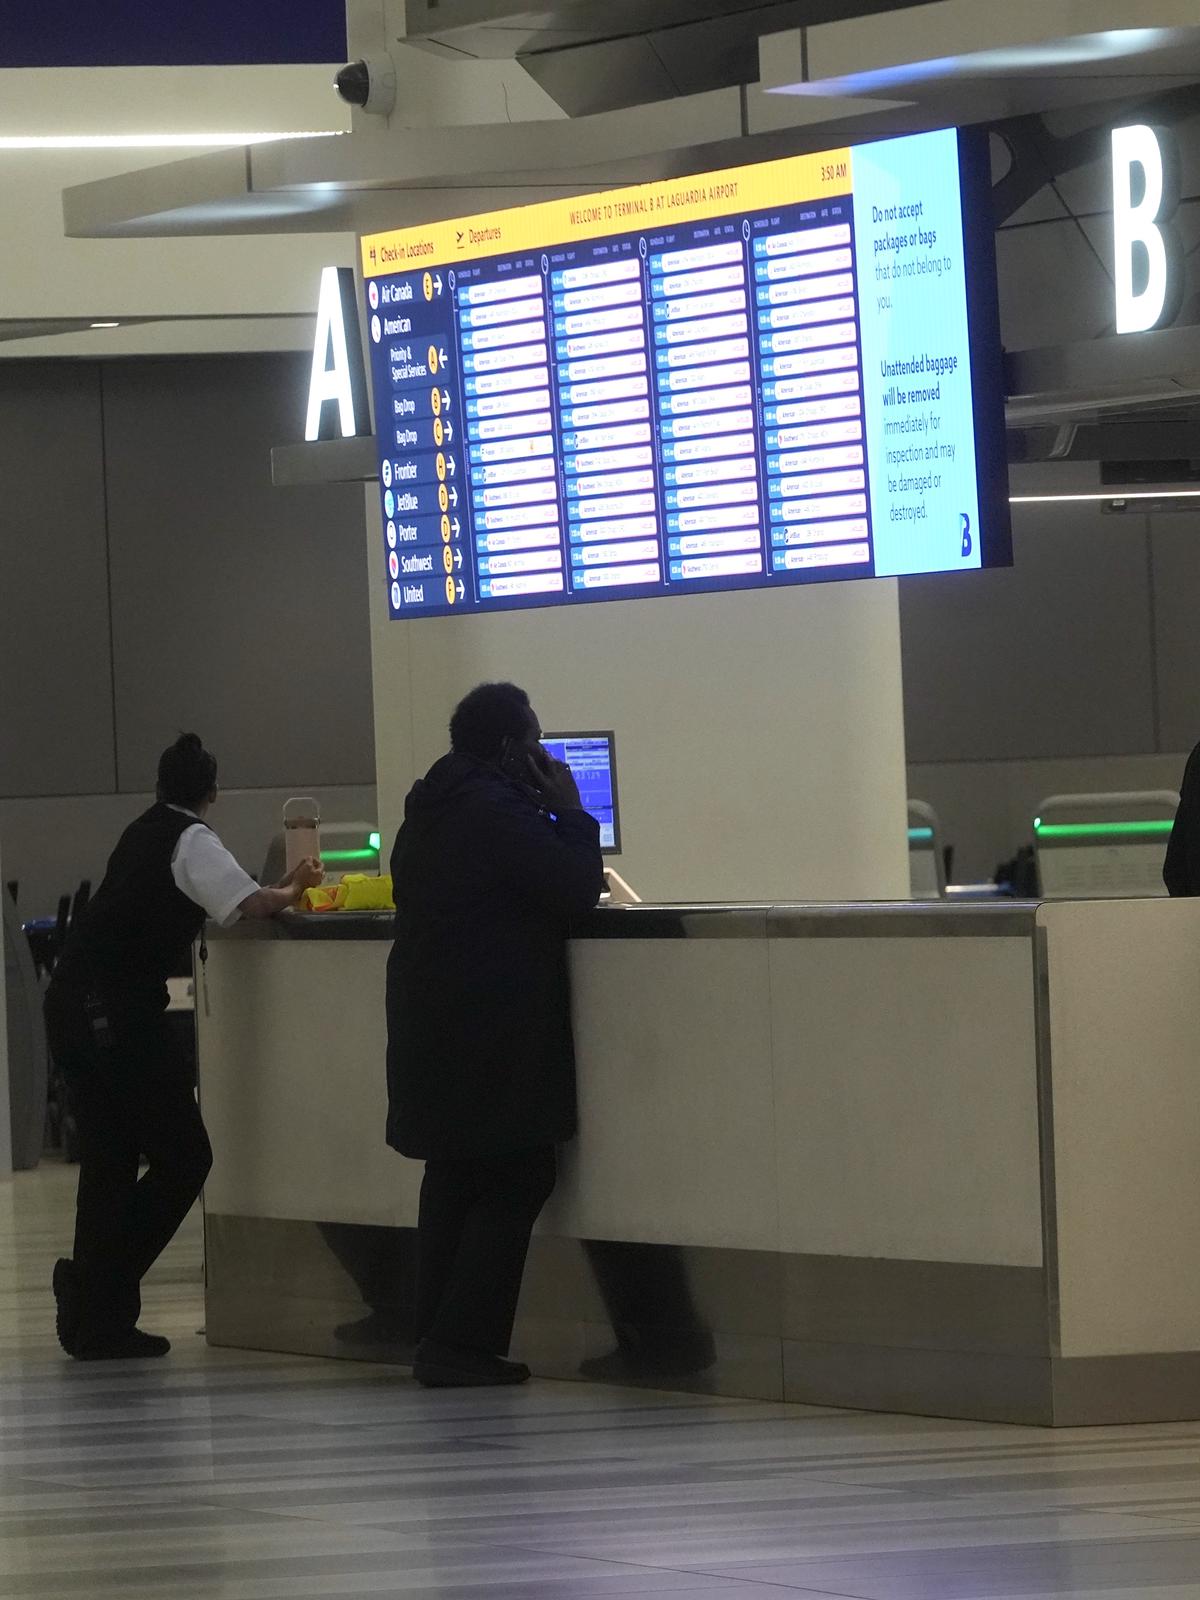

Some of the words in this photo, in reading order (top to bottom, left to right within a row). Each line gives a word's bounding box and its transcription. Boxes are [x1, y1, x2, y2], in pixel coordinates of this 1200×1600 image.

[821, 164, 835, 181] 3:50
[836, 162, 848, 179] AM
[569, 207, 602, 226] WELCOME
[604, 206, 613, 219] TO
[614, 199, 648, 218] TERMINAL
[649, 197, 655, 211] B
[656, 195, 665, 209] AT
[666, 189, 707, 208] LAGUARDIA
[708, 182, 739, 201] AIRPORT
[872, 205, 883, 224] Do
[884, 205, 897, 222] not
[898, 200, 924, 223] accept
[468, 225, 502, 245] Departures
[1111, 124, 1167, 335] B
[380, 242, 405, 263] Check-in
[406, 240, 434, 258] Locations
[873, 231, 908, 256] packages
[909, 233, 917, 247] or
[918, 227, 937, 249] bags
[875, 263, 890, 281] that
[891, 260, 901, 278] do
[902, 260, 916, 277] not
[916, 255, 942, 278] belong
[943, 256, 952, 271] to
[381, 285, 390, 304] Air
[390, 281, 413, 302] Canada
[876, 293, 893, 315] you.
[384, 315, 412, 336] American
[304, 266, 356, 442] A
[390, 347, 407, 364] Priority
[407, 346, 412, 360] &
[880, 354, 925, 378] Unattended
[925, 353, 958, 376] baggage
[392, 366, 408, 383] Special
[408, 363, 428, 378] Services
[882, 386, 896, 407] will
[897, 385, 906, 405] be
[907, 380, 940, 403] removed
[394, 398, 404, 416] Bag
[404, 398, 416, 415] Drop
[883, 412, 928, 436] immediately
[930, 410, 941, 430] for
[396, 430, 406, 447] Bag
[406, 430, 418, 444] Drop
[886, 445, 924, 468] inspection
[924, 443, 939, 461] and
[940, 443, 956, 463] may
[394, 462, 418, 481] Frontier
[888, 474, 898, 493] be
[898, 470, 932, 494] damaged
[933, 474, 942, 489] or
[397, 493, 418, 512] JetBlue
[890, 501, 928, 525] destroyed.
[398, 524, 418, 542] Porter
[401, 554, 433, 573] Southwest
[404, 584, 424, 604] United
